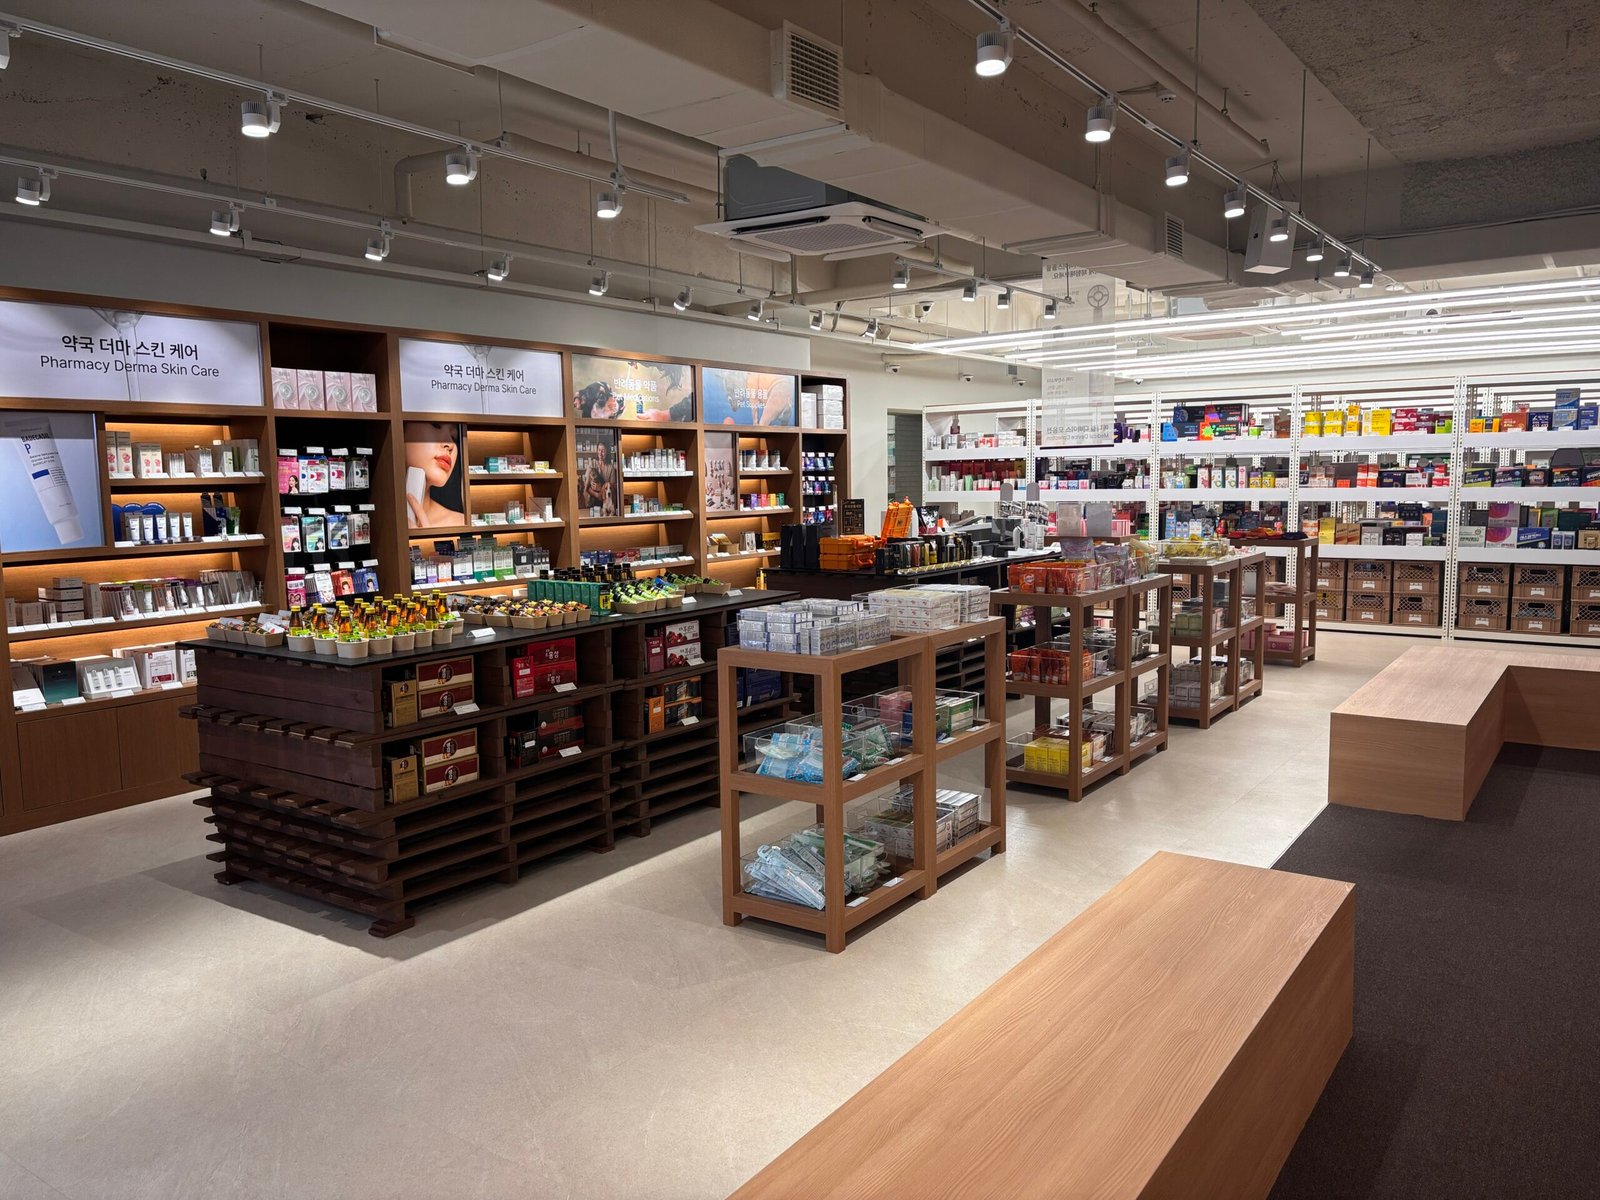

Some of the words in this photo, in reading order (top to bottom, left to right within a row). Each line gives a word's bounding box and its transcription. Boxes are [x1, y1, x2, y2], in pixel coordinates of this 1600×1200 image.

[61, 335, 95, 353] 약국
[99, 338, 130, 356] 더마
[135, 341, 166, 358] 스킨
[169, 343, 199, 361] 케어
[40, 355, 110, 374] Pharmacy
[115, 360, 157, 374] Derma
[161, 362, 188, 376] Skin
[191, 365, 220, 377] Care
[444, 365, 463, 378] 약국
[466, 366, 484, 379] 더마
[487, 368, 505, 381] 스킨
[507, 370, 524, 382] 케어
[431, 380, 473, 393] Pharmacy
[474, 382, 500, 393] Derma
[501, 383, 518, 394] Skin
[519, 385, 537, 395] Care
[613, 377, 642, 390] 반려동물
[24, 443, 31, 454] P
